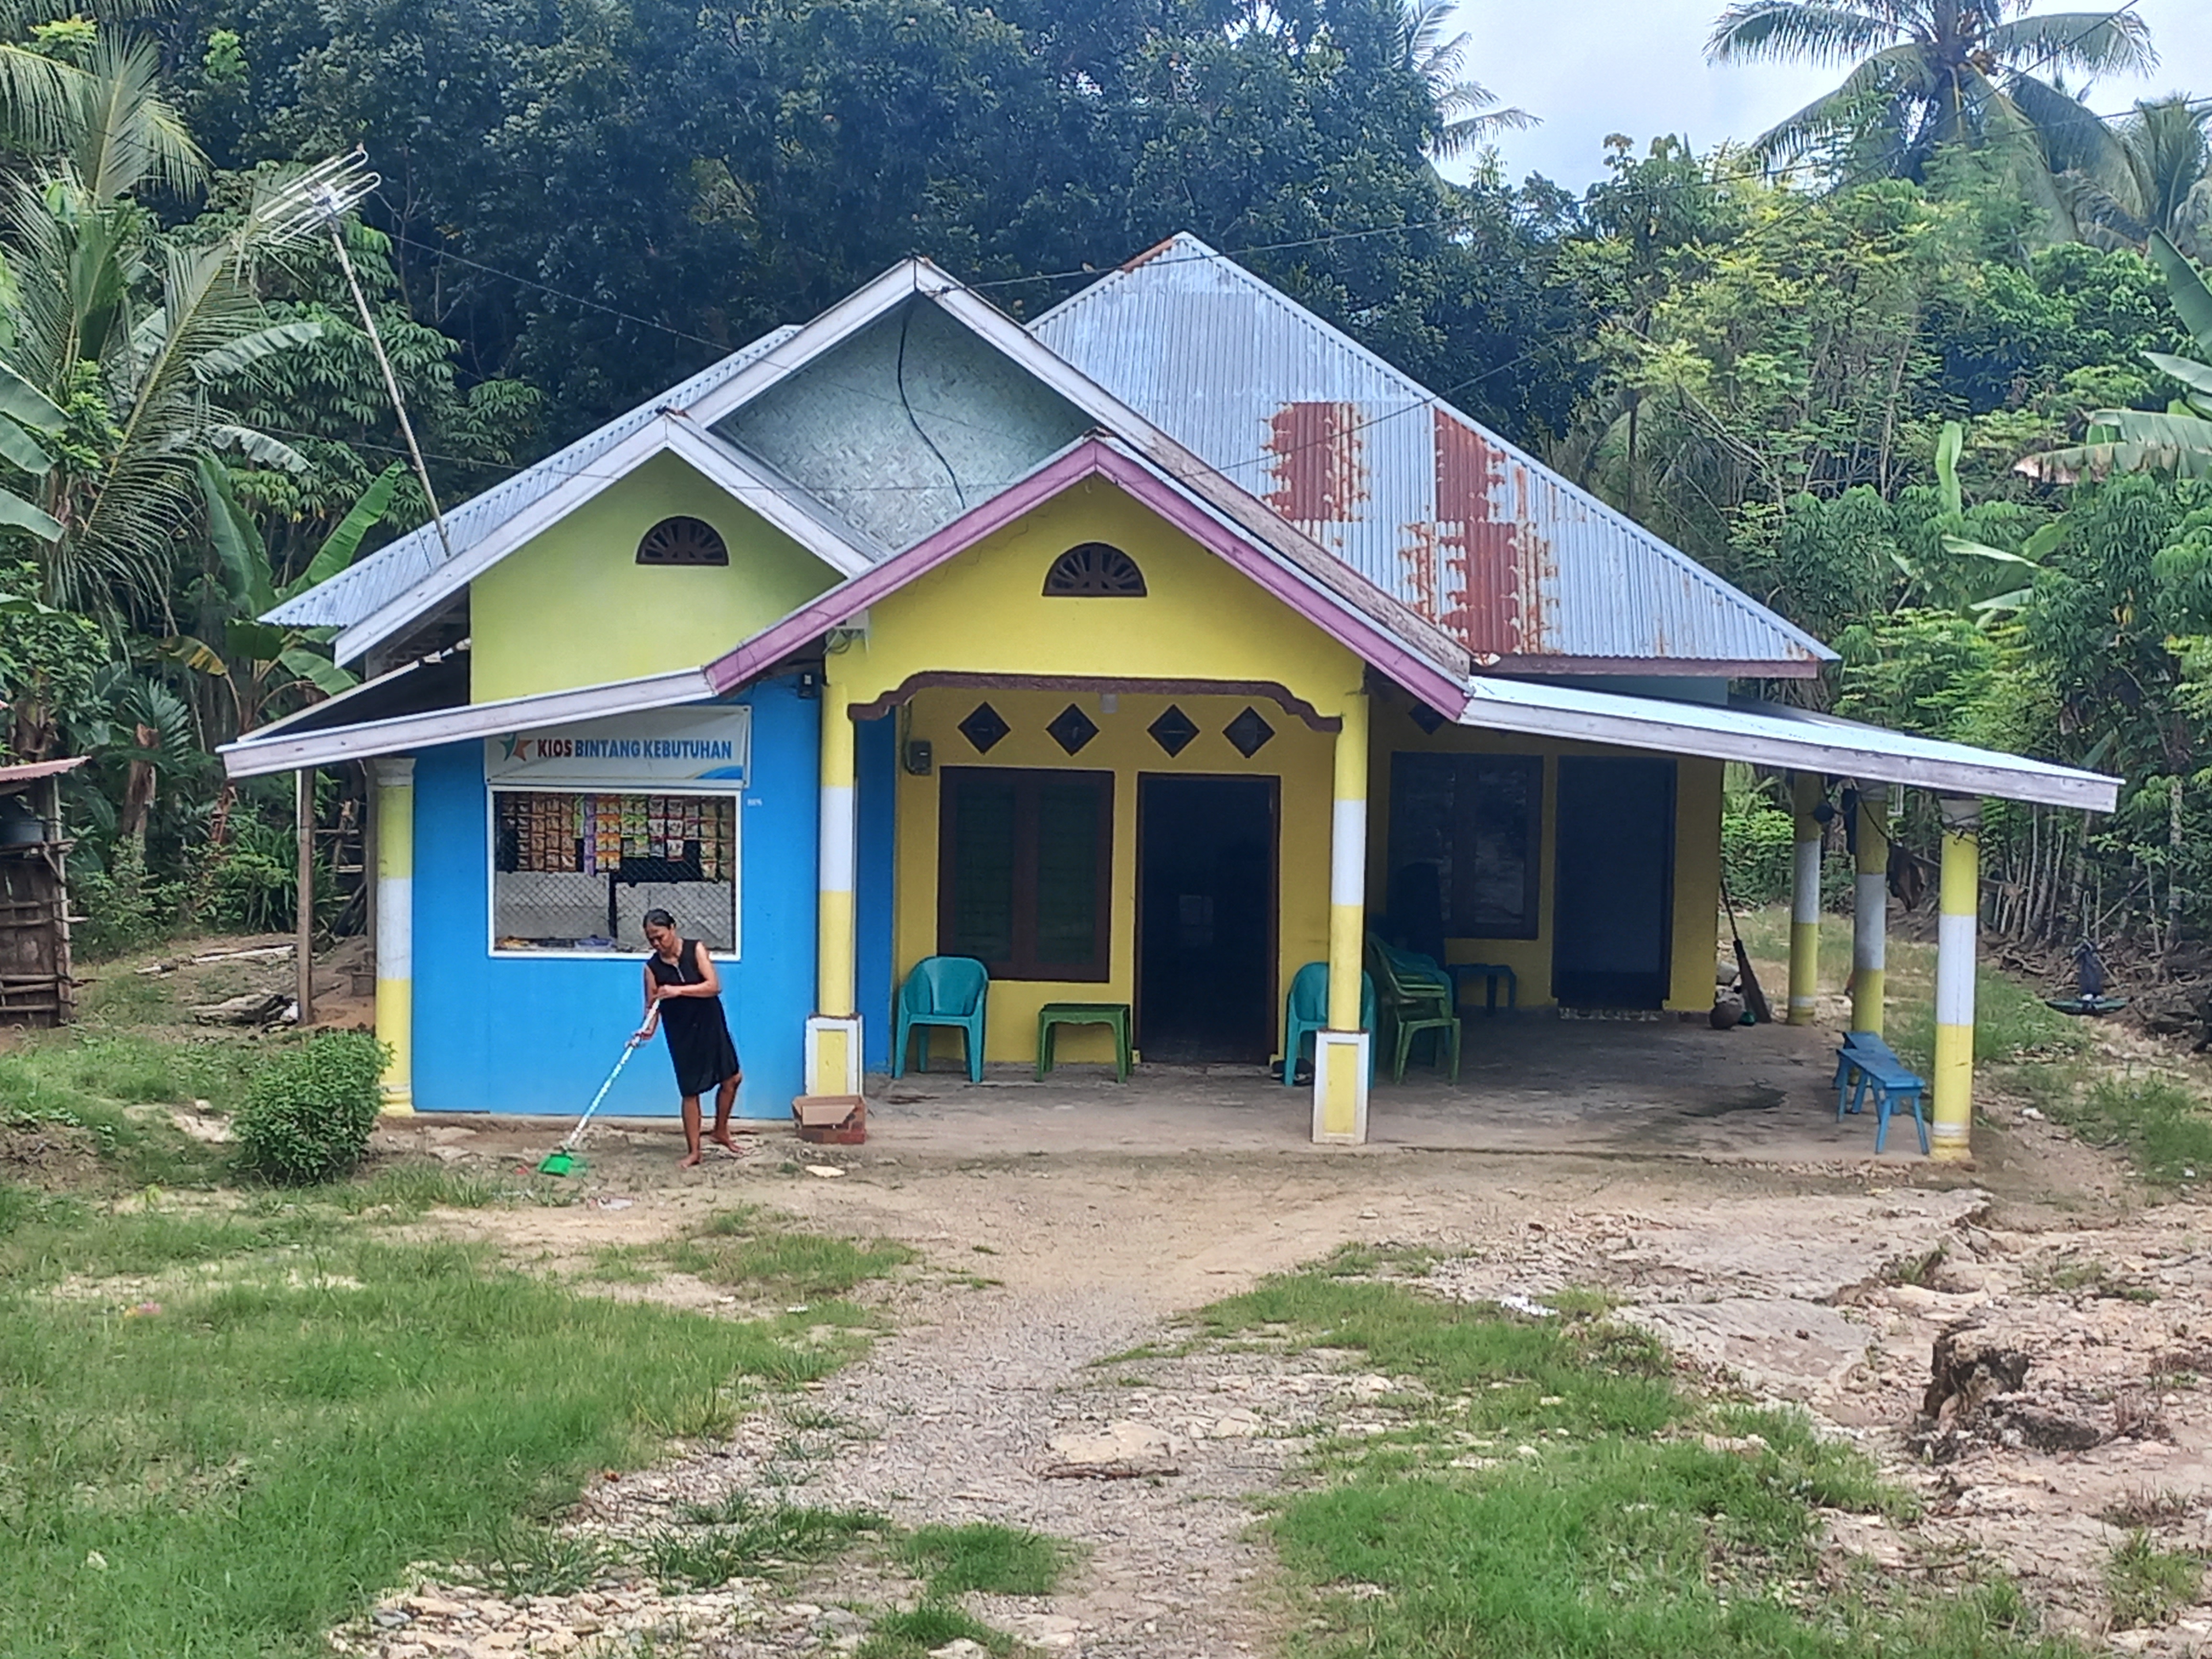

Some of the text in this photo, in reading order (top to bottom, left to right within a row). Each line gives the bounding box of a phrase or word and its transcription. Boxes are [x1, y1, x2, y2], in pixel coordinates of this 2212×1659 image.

[537, 739, 731, 759] KIOS BINTANG KEBUTUHAN
